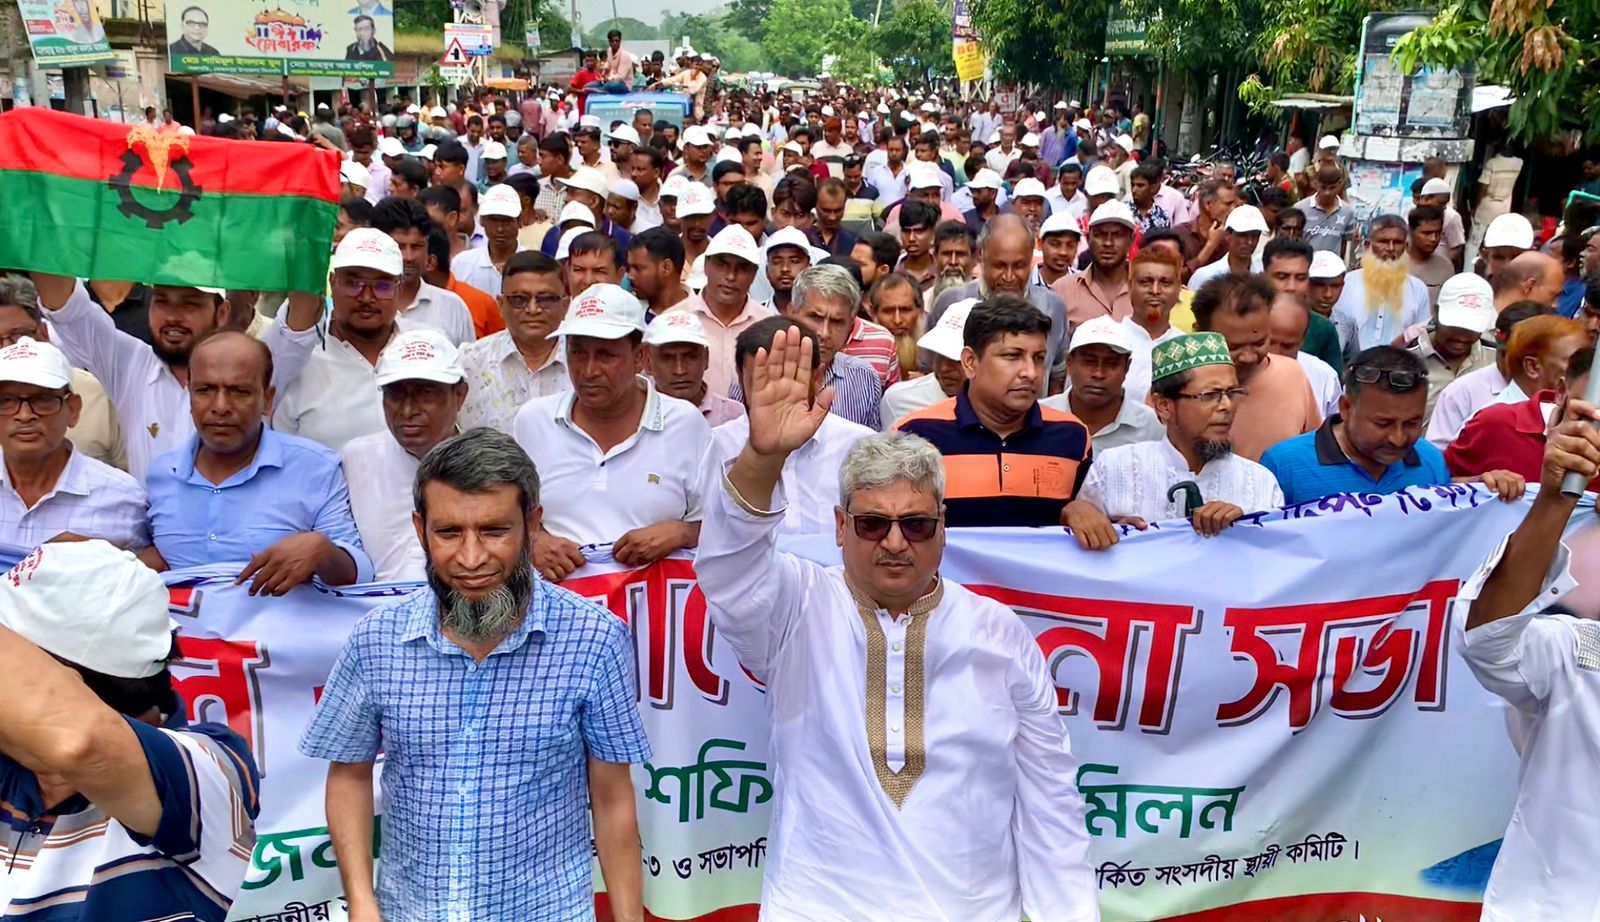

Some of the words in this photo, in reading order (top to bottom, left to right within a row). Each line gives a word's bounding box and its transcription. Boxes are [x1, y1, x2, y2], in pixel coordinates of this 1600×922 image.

[1216, 578, 1463, 736] সভা
[1076, 763, 1247, 839] মিলন
[672, 857, 692, 879] ও
[1155, 854, 1238, 887] সংসদীয়
[1243, 843, 1283, 879] স্থায়ী
[1286, 831, 1349, 864] কমিটি
